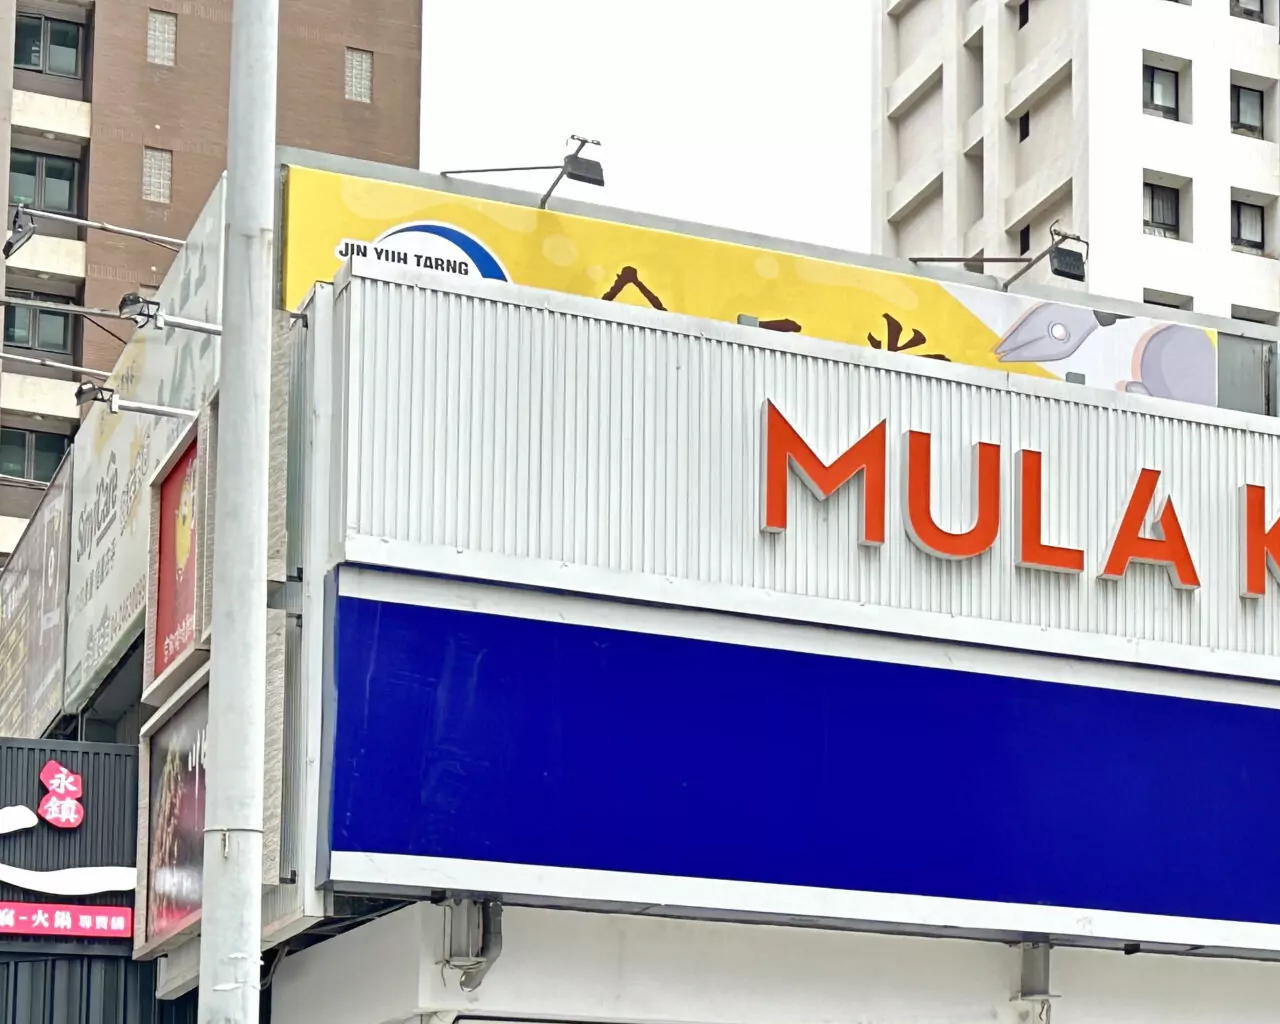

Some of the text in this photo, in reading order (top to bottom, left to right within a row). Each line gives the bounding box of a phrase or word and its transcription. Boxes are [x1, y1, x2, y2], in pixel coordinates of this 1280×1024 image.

[339, 243, 367, 258] JIN
[414, 254, 469, 276] TARNG
[760, 398, 1201, 592] MULA
